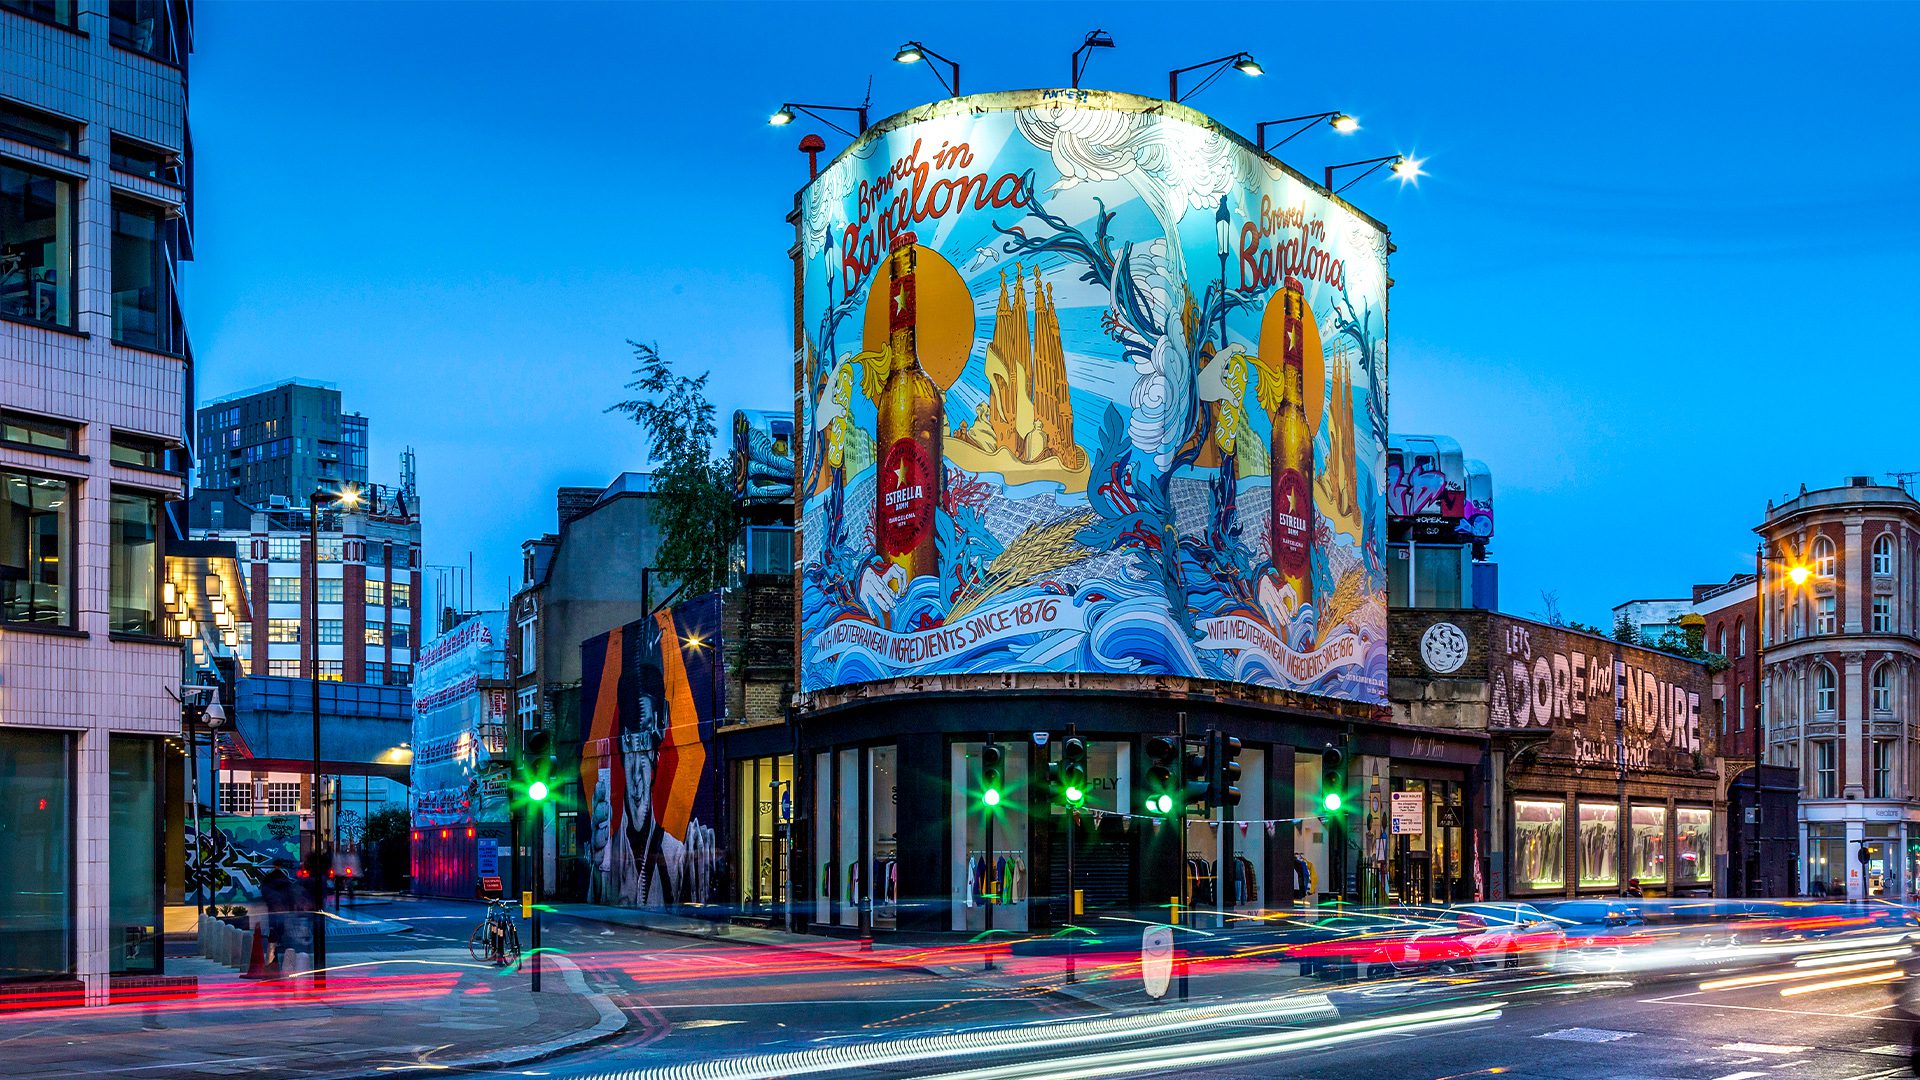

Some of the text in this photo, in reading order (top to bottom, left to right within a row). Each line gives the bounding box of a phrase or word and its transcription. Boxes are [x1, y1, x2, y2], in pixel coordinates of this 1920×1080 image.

[859, 138, 973, 223] Brewed in
[842, 162, 1031, 298] Barcelona
[1260, 194, 1325, 242] Brewed in
[1236, 221, 1344, 292] Barcelona
[885, 485, 923, 506] ESTRELLA
[1280, 513, 1306, 531] ESTRELLA
[818, 599, 1061, 663] WITH MEDITERRANEAN INGREDIENTS SINCE 1876
[1206, 619, 1354, 681] WITH MEDITERRANEAN INGREDIENTS SINCE 1876
[1490, 651, 1699, 754] ADORE And ENDURE
